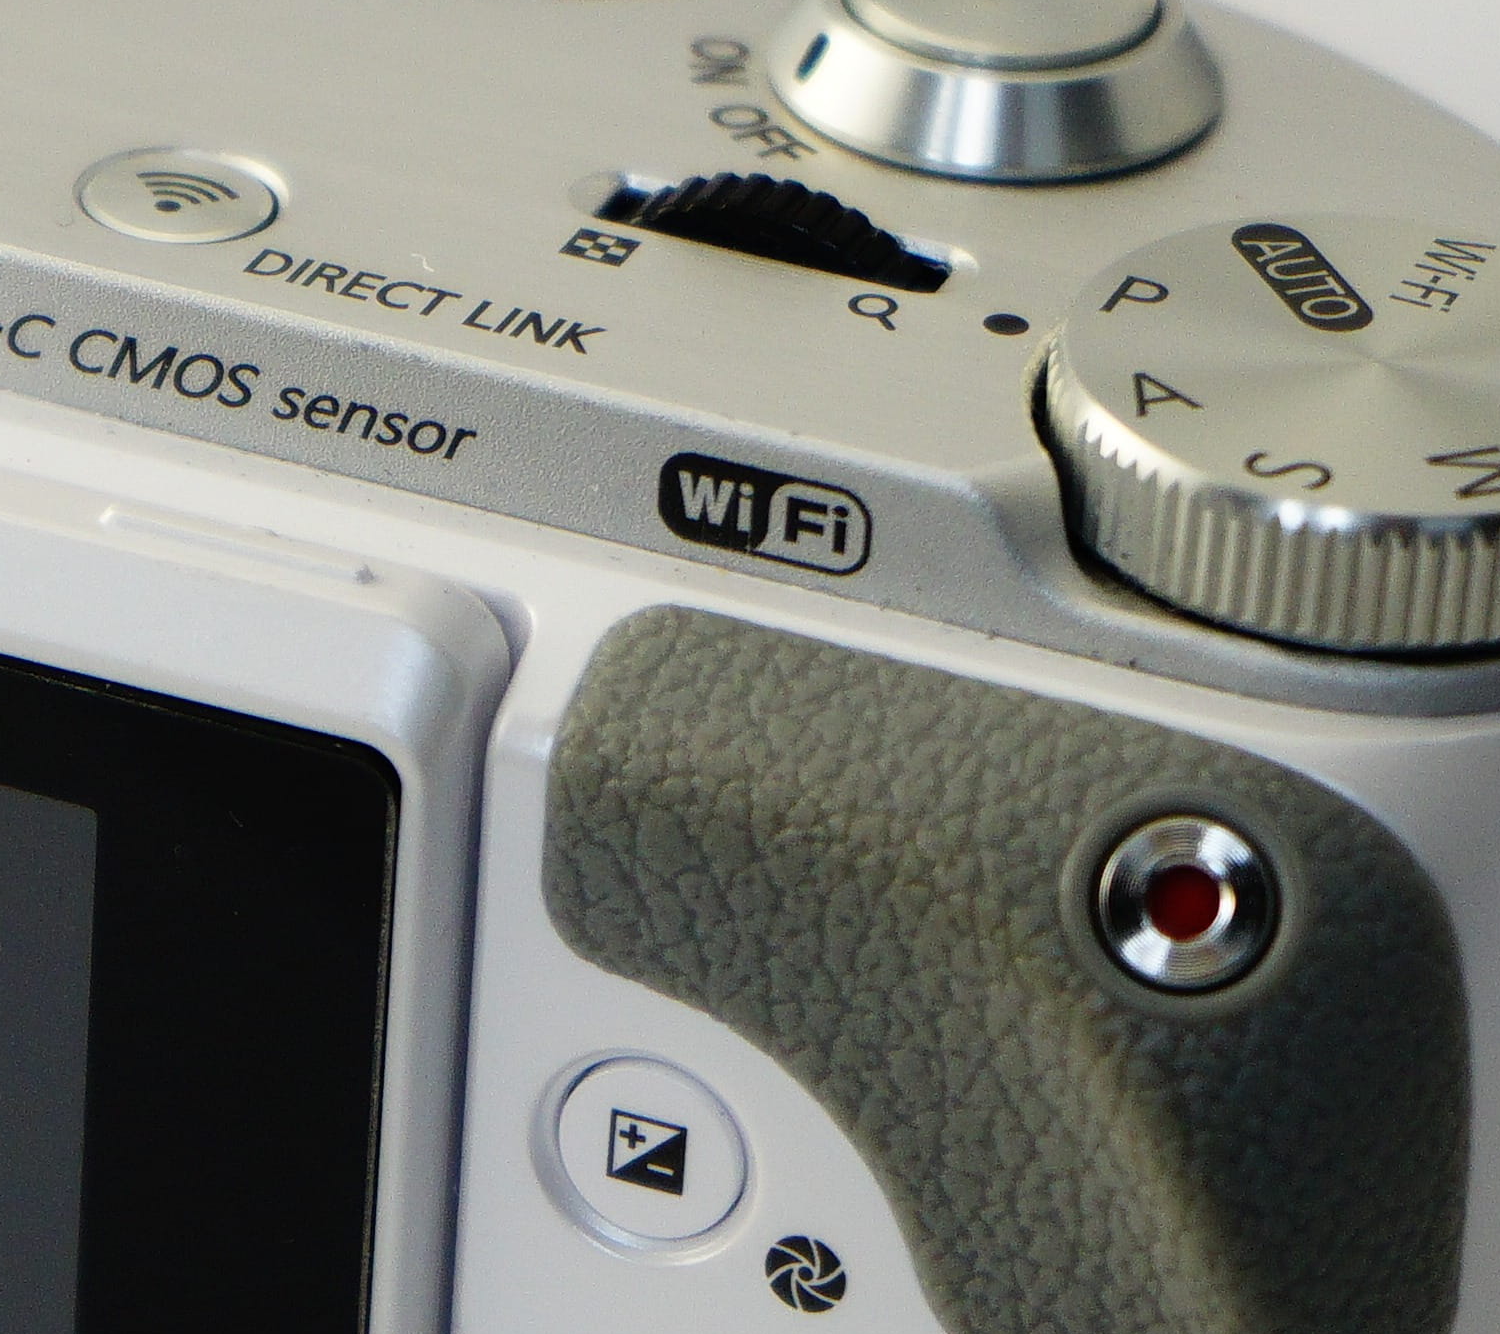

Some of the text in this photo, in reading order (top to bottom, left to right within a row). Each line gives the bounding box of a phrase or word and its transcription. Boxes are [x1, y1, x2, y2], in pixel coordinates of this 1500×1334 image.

[709, 103, 818, 161] OFF
[243, 248, 607, 354] DIRECT LINK
[1099, 275, 1170, 313] P
[1241, 237, 1360, 321] AUTO
[1388, 237, 1498, 312] Wi-Fi
[67, 327, 262, 409] CMOS
[272, 385, 477, 461] sensor
[1133, 371, 1205, 417] A
[1243, 449, 1332, 490] S
